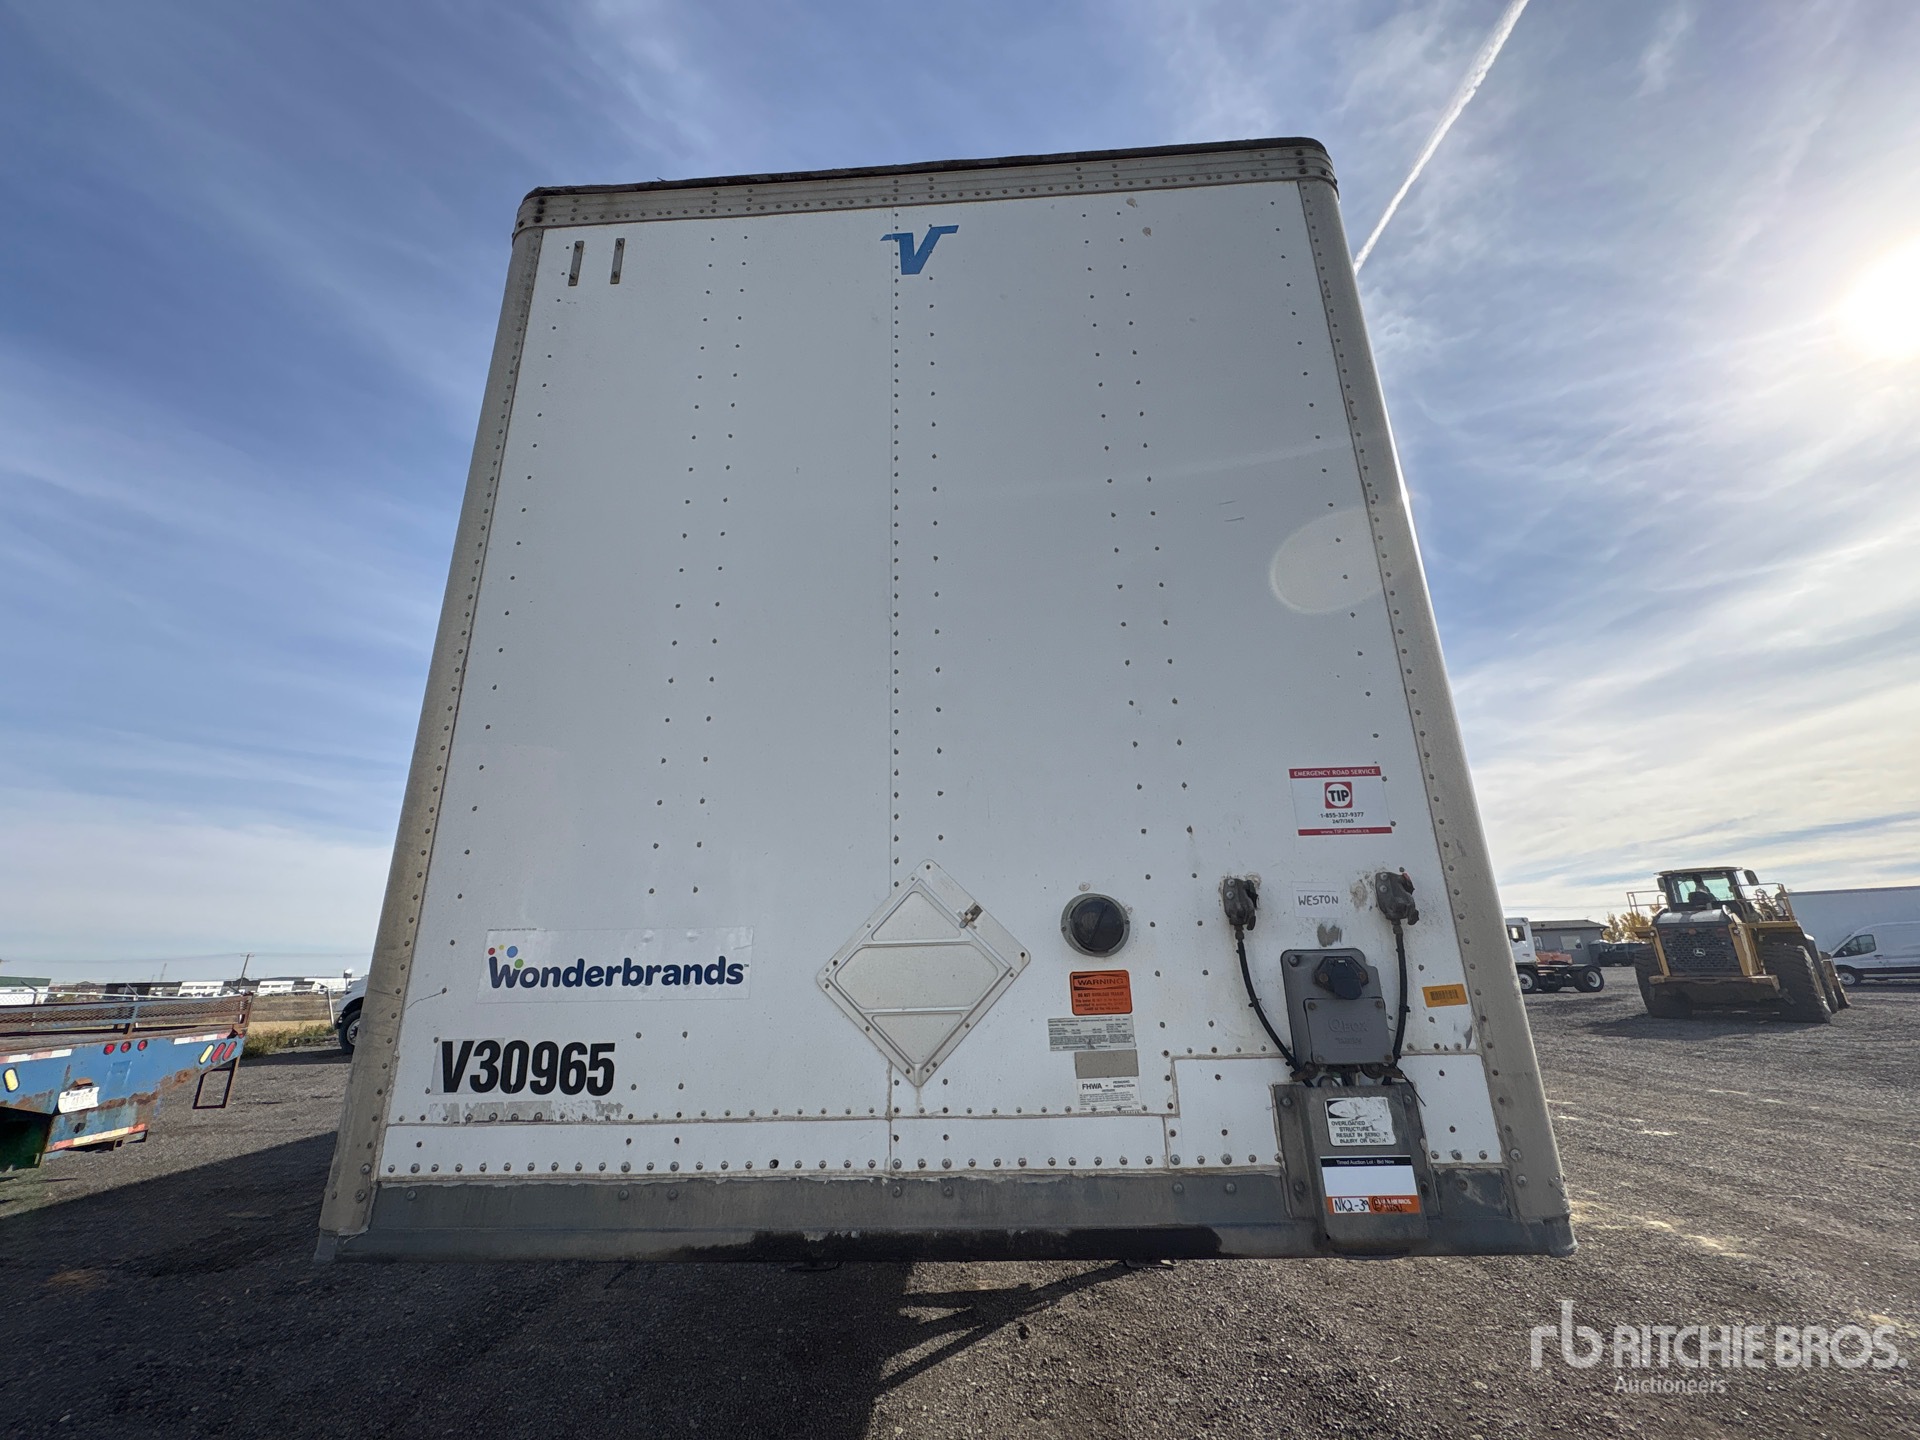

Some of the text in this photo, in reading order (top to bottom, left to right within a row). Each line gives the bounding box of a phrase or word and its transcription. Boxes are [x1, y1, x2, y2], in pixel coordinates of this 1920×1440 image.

[1293, 769, 1331, 777] EMERGENCY
[1328, 790, 1350, 802] TIP
[1297, 895, 1339, 906] WESTON
[441, 1040, 616, 1096] V30965
[1081, 1082, 1103, 1090] FHWA
